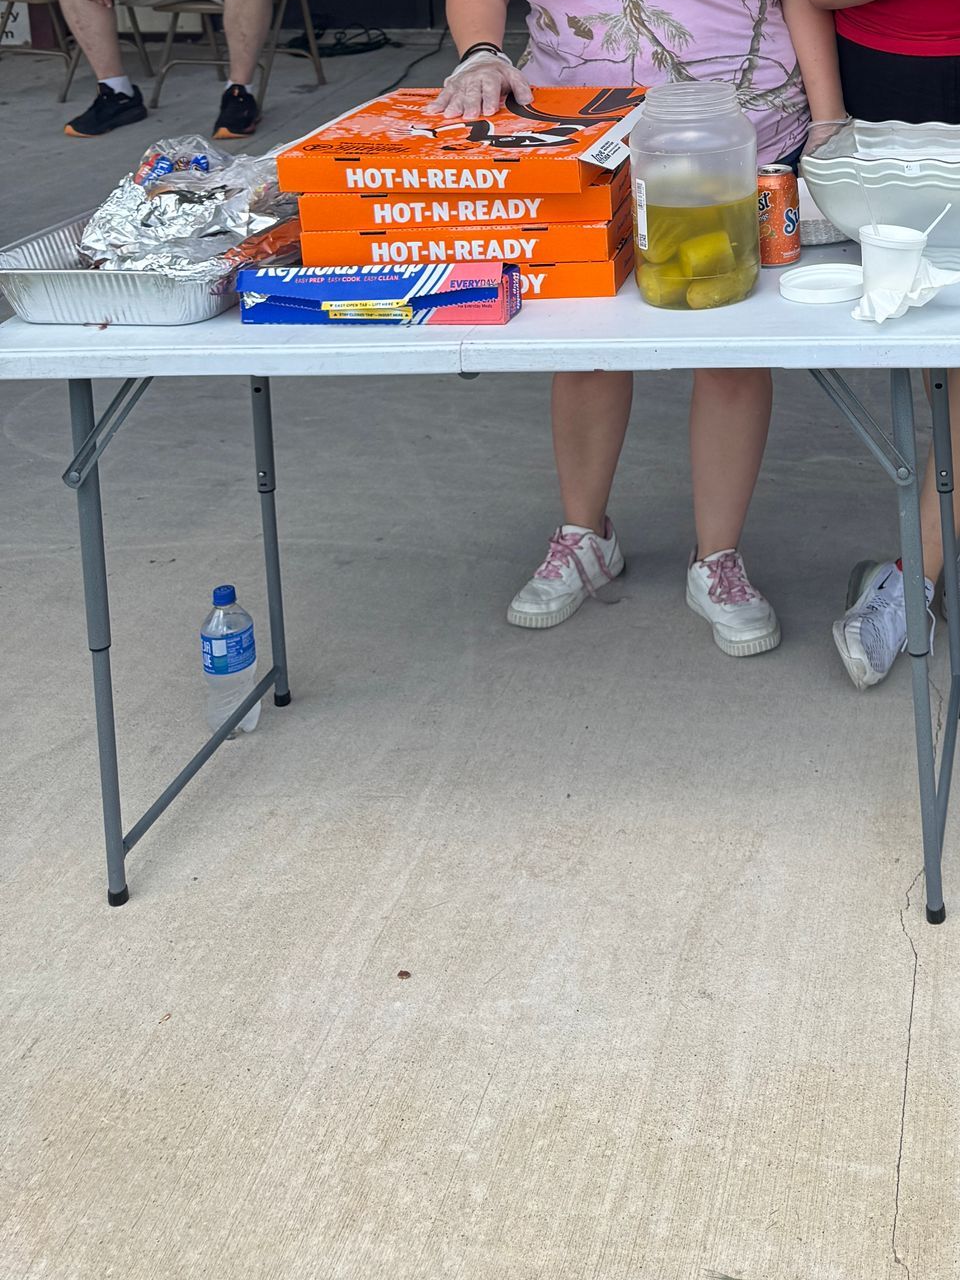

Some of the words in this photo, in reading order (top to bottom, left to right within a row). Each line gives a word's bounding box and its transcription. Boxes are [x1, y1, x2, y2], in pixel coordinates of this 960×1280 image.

[346, 167, 510, 189] HOT-N-READY
[373, 198, 542, 224] HOT-N-READY
[371, 238, 537, 262] HOT-N-READY
[450, 278, 497, 289] EVERYDAY
